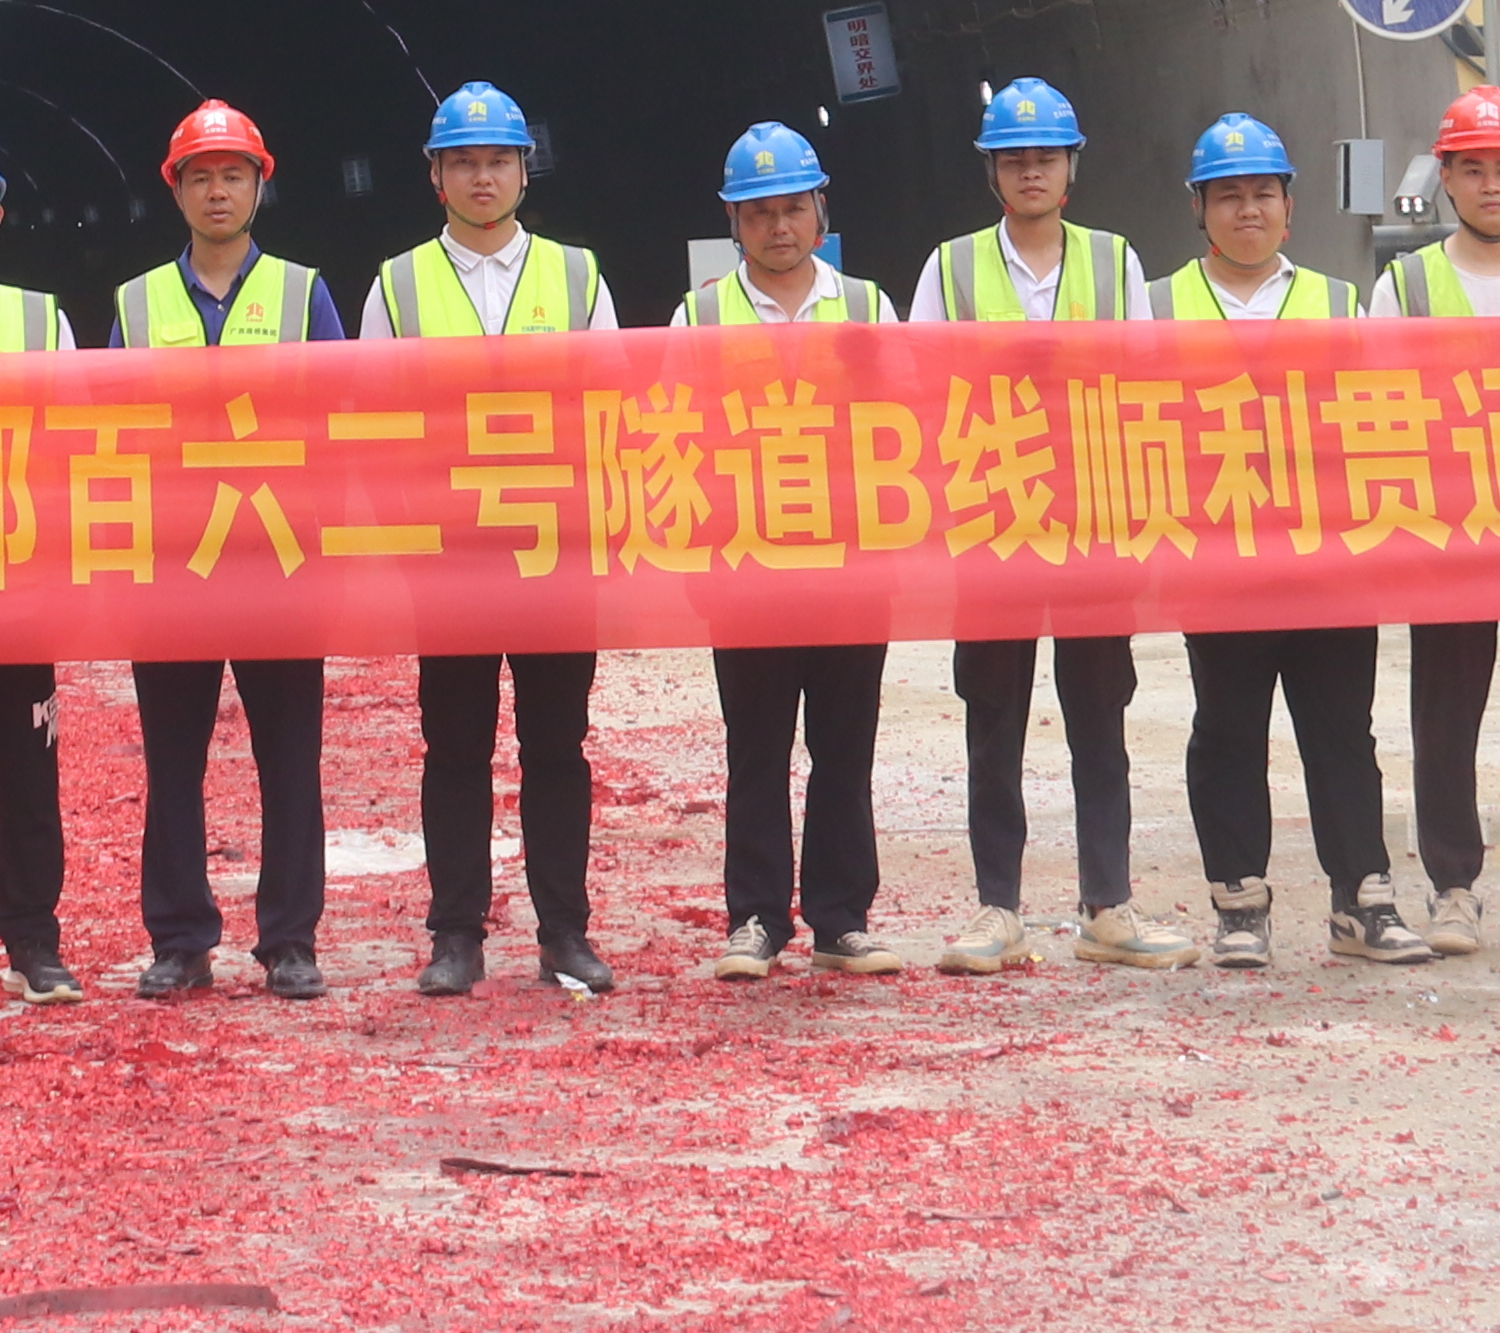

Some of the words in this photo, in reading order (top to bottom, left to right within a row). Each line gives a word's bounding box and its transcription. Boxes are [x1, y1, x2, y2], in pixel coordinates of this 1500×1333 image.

[847, 19, 878, 90] 明暗交界处
